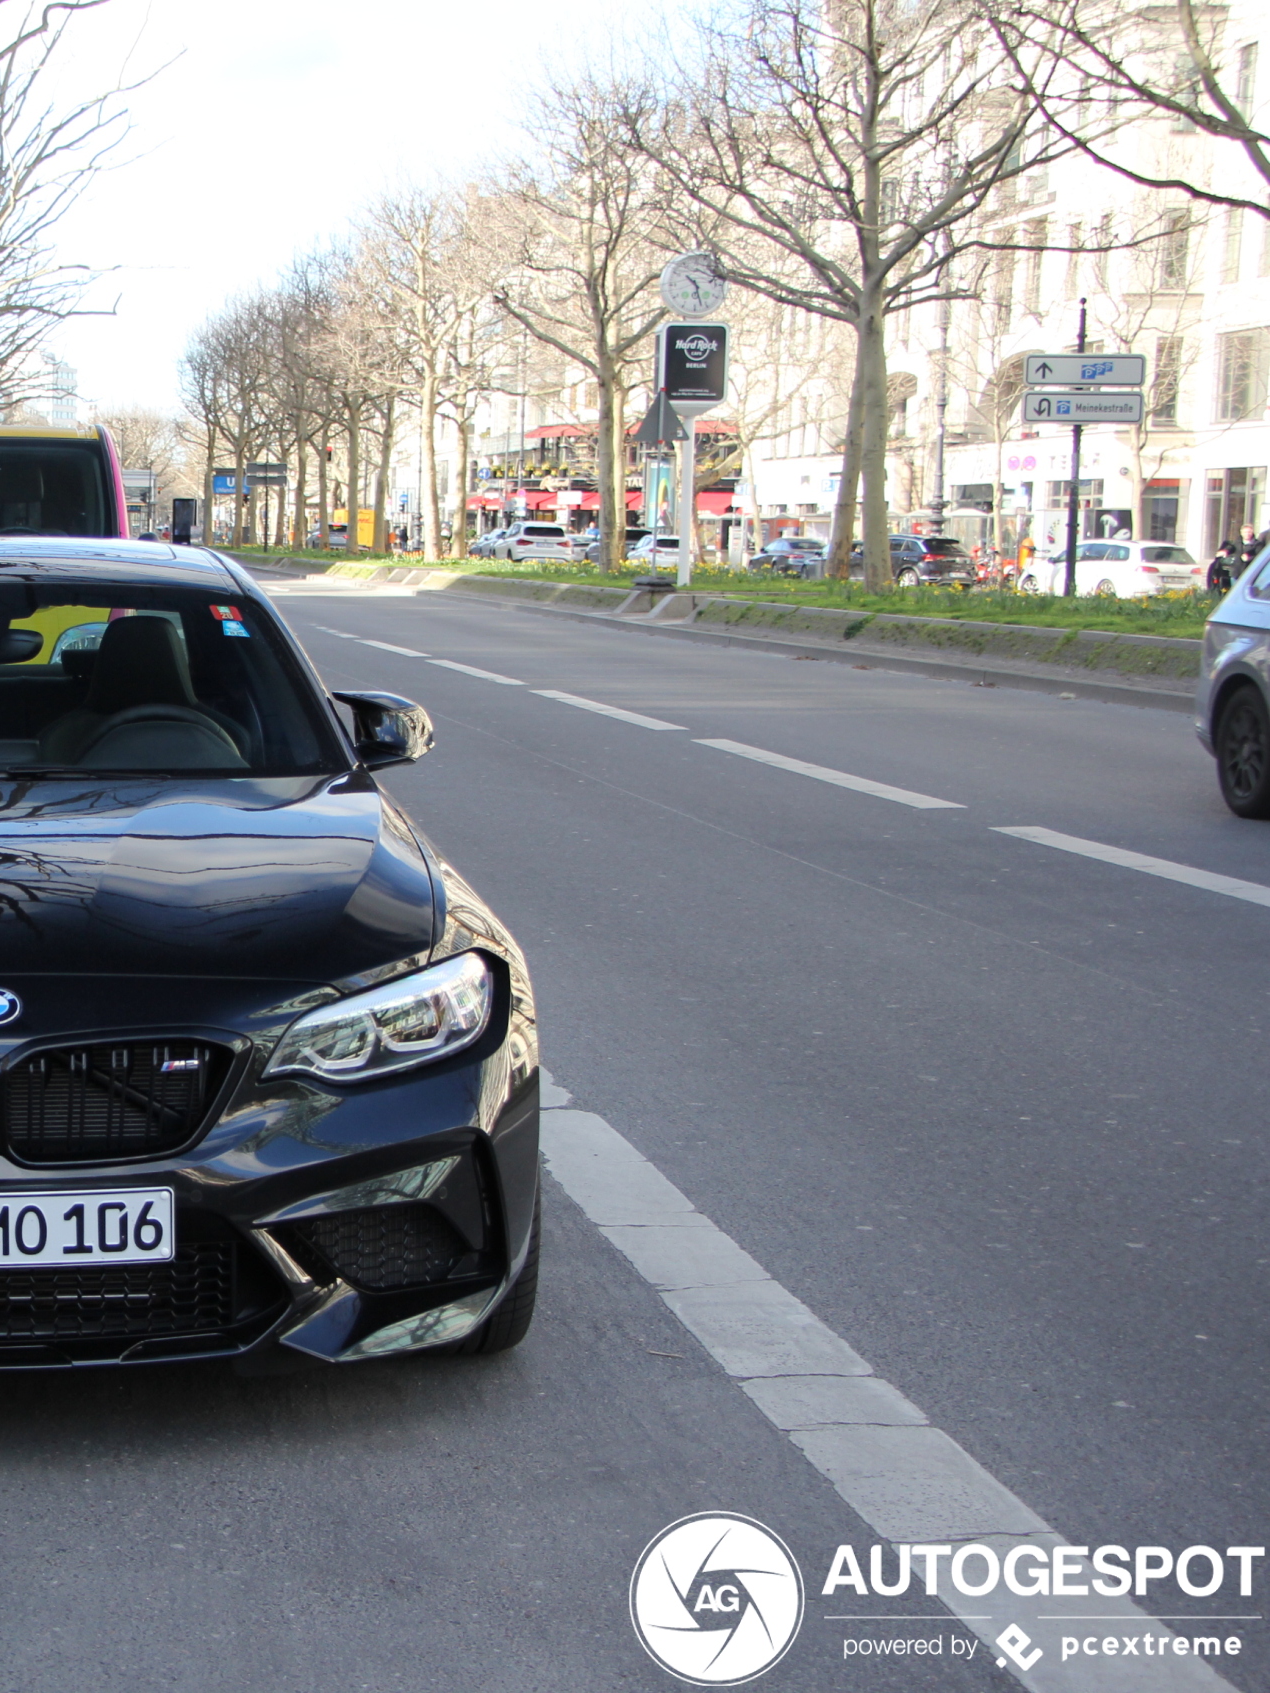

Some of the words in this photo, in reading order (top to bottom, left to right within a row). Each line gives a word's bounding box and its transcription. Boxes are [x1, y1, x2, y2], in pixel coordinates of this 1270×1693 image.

[675, 339, 697, 349] Hard
[697, 339, 718, 351] Rock
[1075, 402, 1134, 413] Meinekestraße
[62, 1200, 164, 1254] 106
